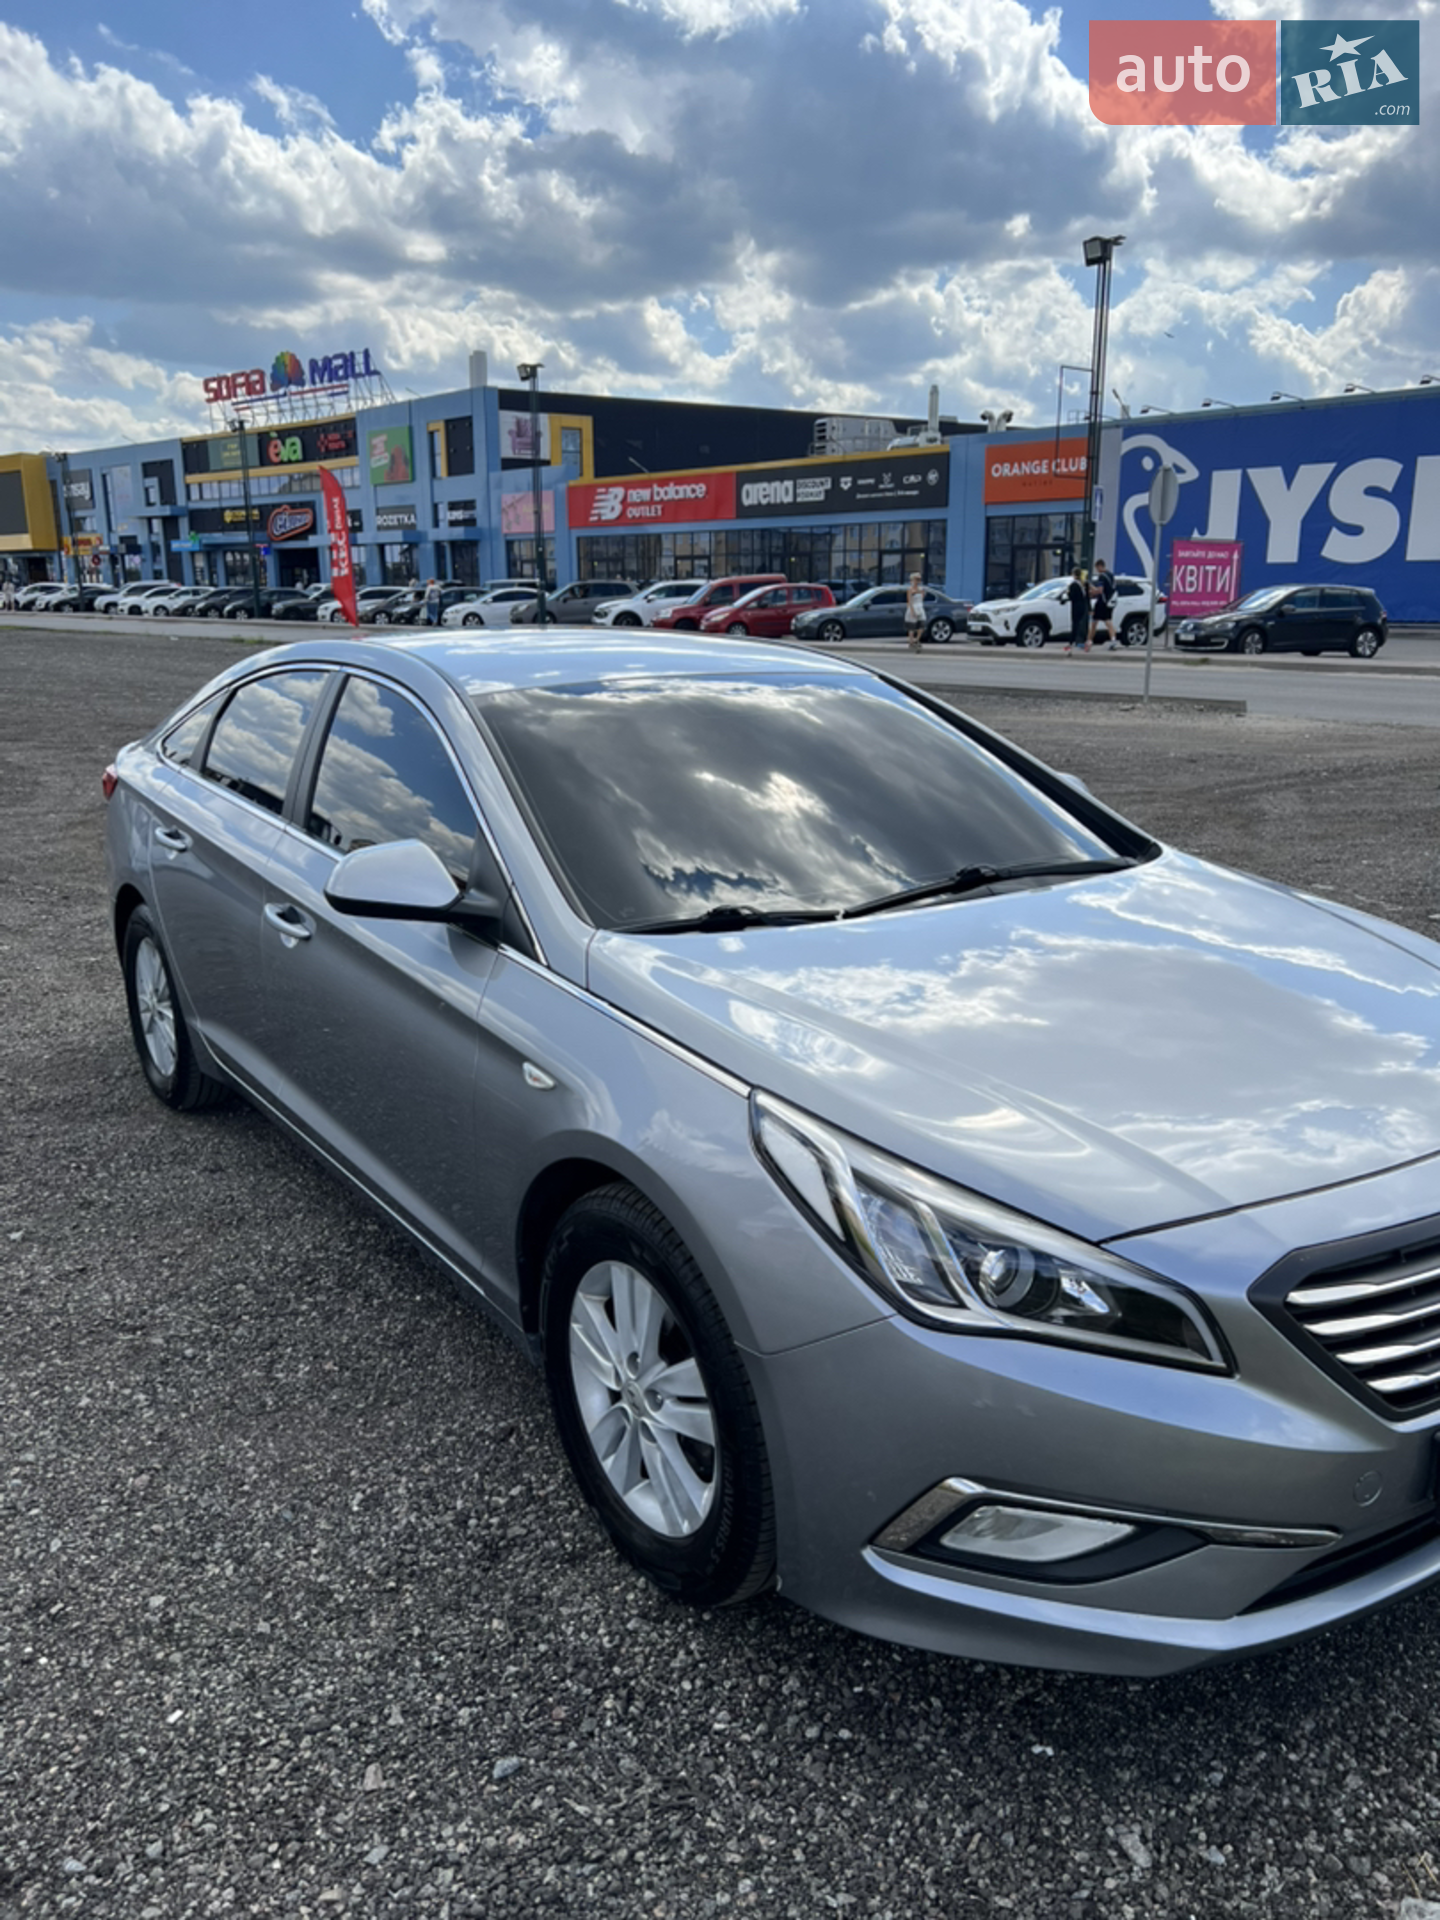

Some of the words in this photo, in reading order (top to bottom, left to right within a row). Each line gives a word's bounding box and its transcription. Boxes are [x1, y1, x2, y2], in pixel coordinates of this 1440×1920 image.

[991, 459, 1050, 478] ORANGE
[1052, 456, 1087, 474] CLUB
[627, 488, 652, 503] new
[653, 482, 707, 502] balance
[741, 480, 794, 506] arena
[626, 504, 663, 519] OUTLET
[1173, 565, 1230, 593] КВІТИ
